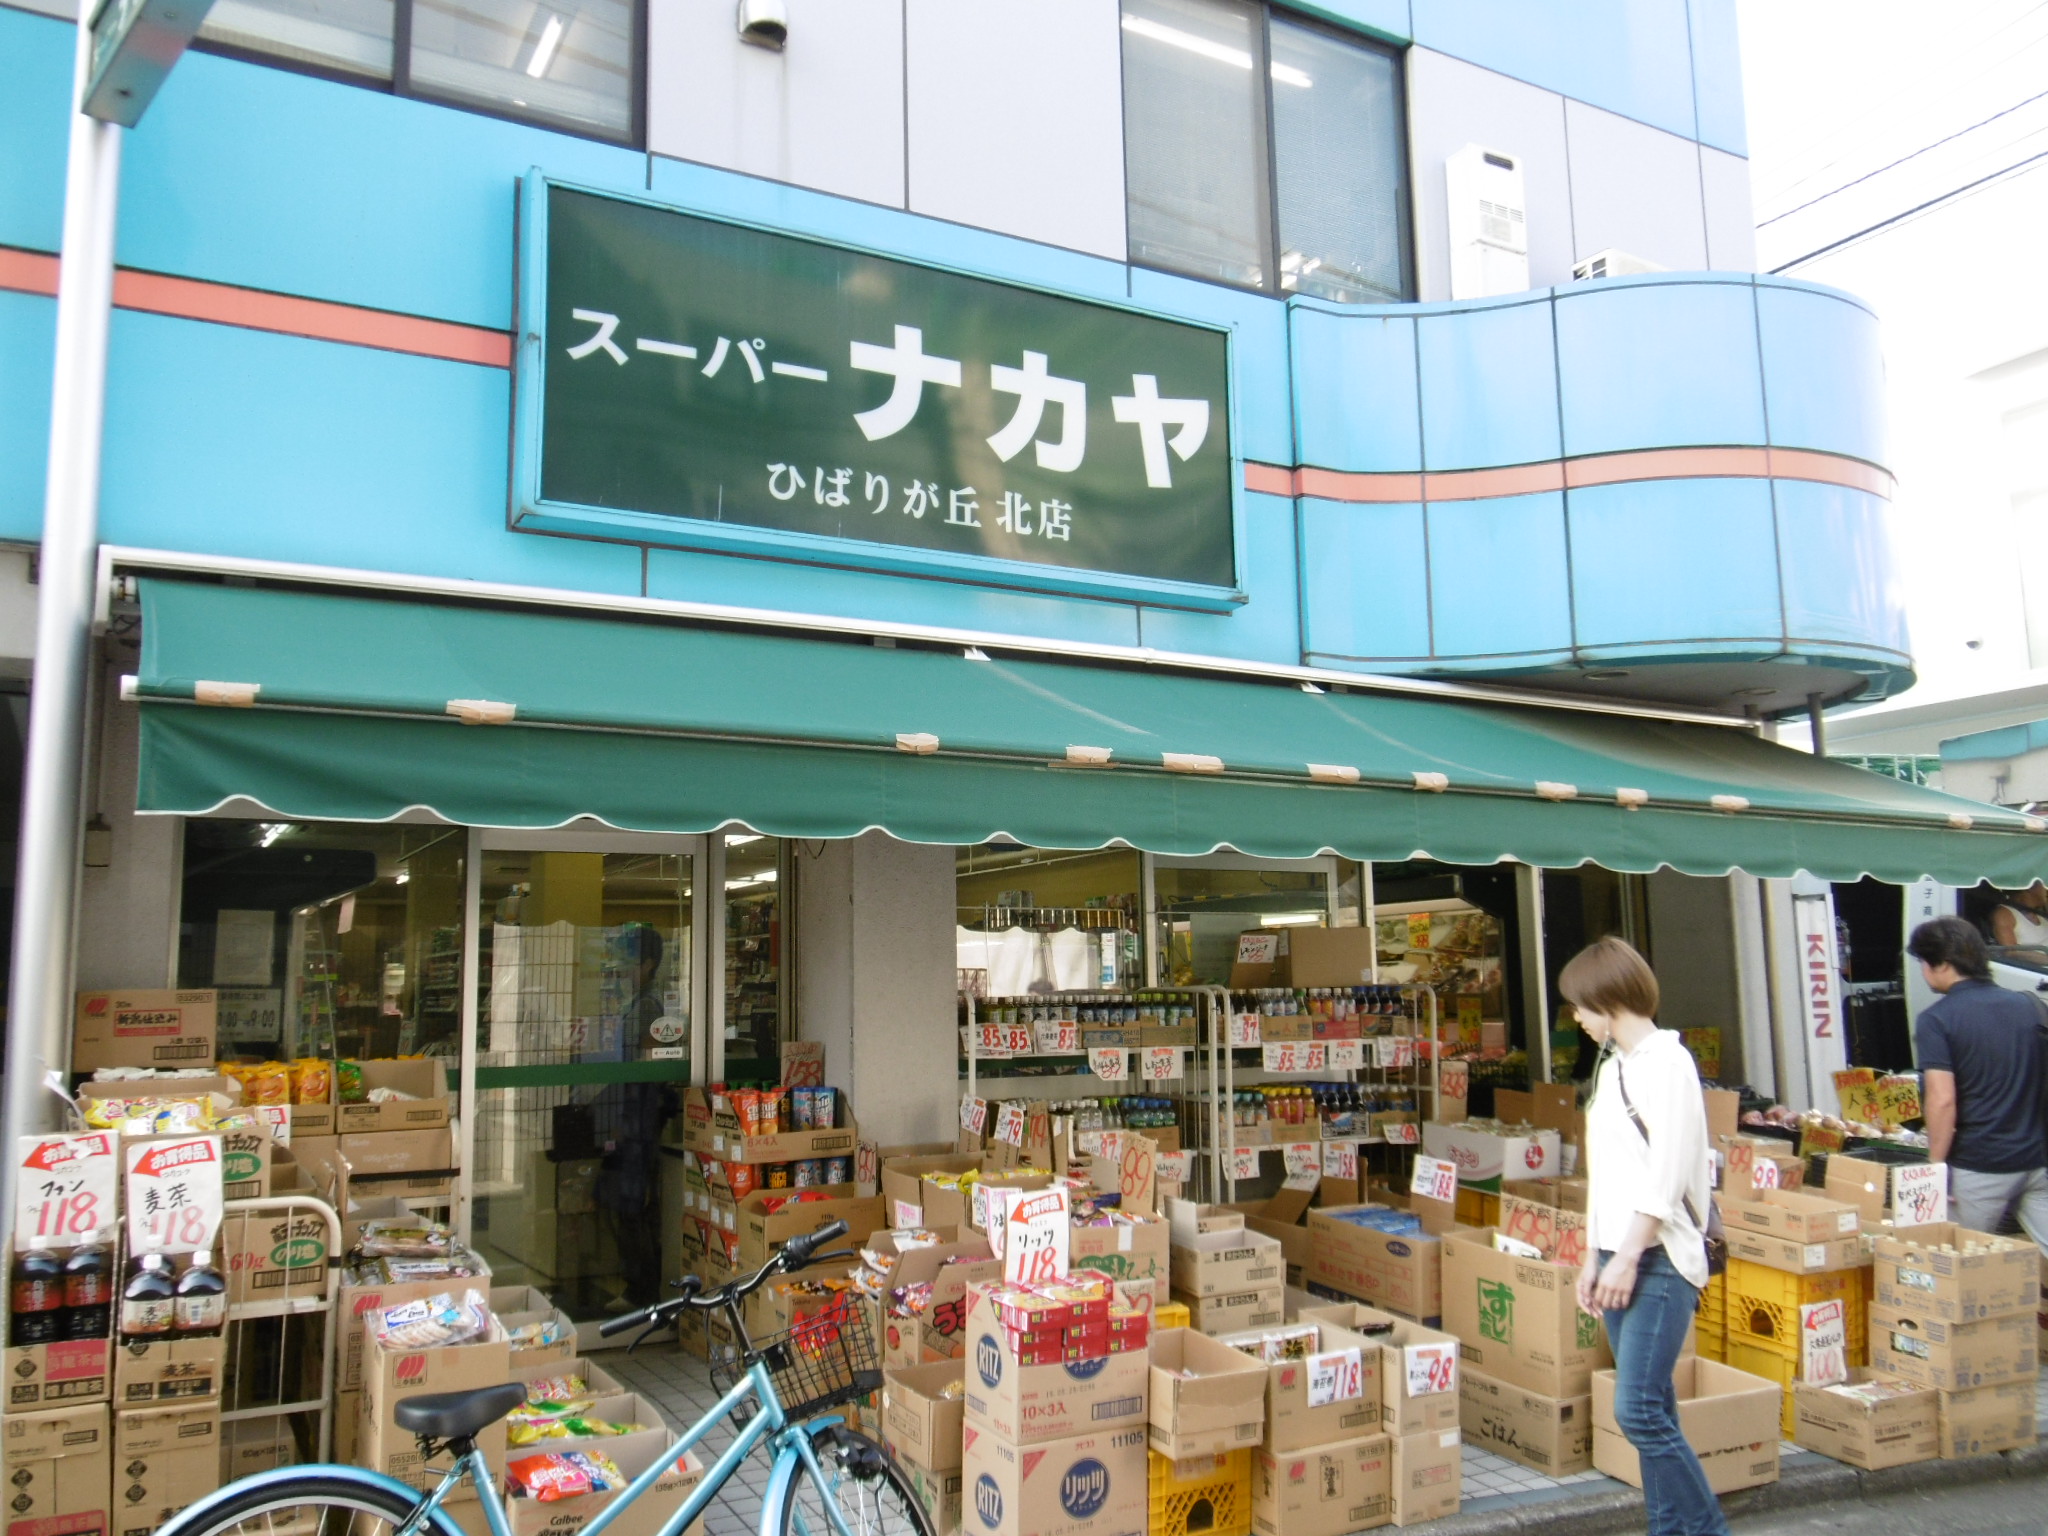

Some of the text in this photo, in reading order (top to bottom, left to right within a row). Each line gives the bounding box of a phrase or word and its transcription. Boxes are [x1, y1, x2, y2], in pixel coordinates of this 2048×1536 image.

[566, 307, 1211, 490] スーパー ナカヤ
[766, 460, 1074, 543] ひばりが丘北店
[1806, 933, 1834, 1039] KIRIN
[983, 1028, 1001, 1048] 85
[1010, 1031, 1028, 1050] 85
[1058, 1029, 1074, 1050] 85
[1278, 1052, 1295, 1071] 85
[1306, 1050, 1323, 1069] 85
[150, 1141, 209, 1170] お買得品
[1122, 1146, 1151, 1199] 89
[36, 1191, 99, 1236] 118
[144, 1183, 192, 1215] 麦茶
[1023, 1194, 1060, 1218] お買得品
[147, 1205, 206, 1245] 118
[1019, 1230, 1055, 1249] リッツ
[230, 1252, 267, 1272] 60g
[1018, 1246, 1057, 1284] 118
[162, 1362, 197, 1377] 麦茶
[979, 1340, 1001, 1383] RITZ
[1428, 1357, 1454, 1392] 98
[1809, 1350, 1838, 1382] 100
[1022, 1403, 1067, 1421] 10×3入
[1110, 1432, 1144, 1449] 11105
[1480, 1416, 1521, 1450] ごはん
[977, 1481, 1001, 1523] RITZ
[1065, 1470, 1106, 1508] リッツ
[550, 1514, 584, 1526] Calbee
